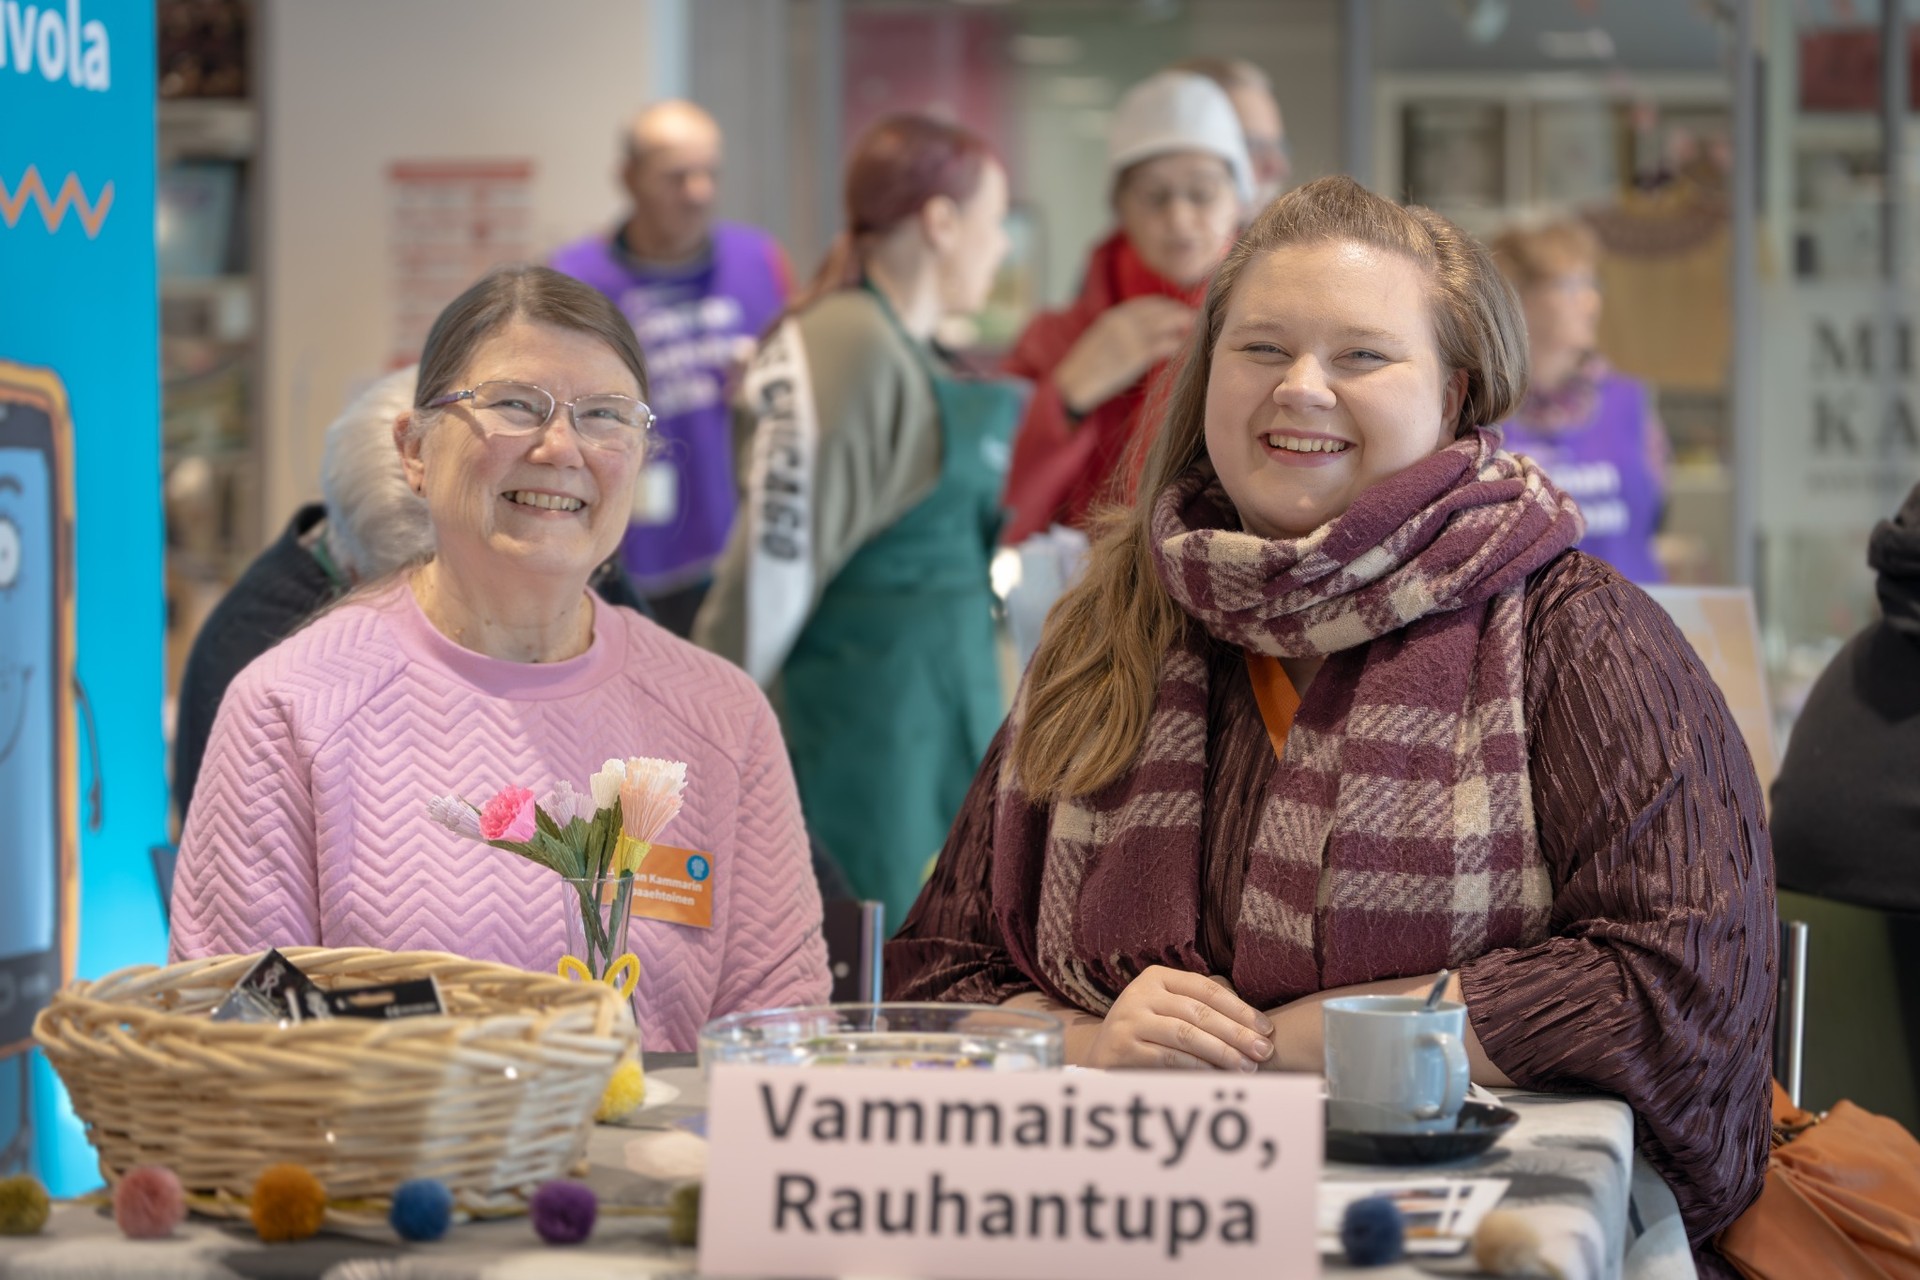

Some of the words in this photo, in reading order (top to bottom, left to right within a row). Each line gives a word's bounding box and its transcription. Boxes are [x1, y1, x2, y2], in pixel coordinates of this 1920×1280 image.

[649, 873, 703, 893] Kammarin
[761, 1085, 1276, 1166] Vammaistyö,
[773, 1174, 1257, 1260] Rauhantupa
